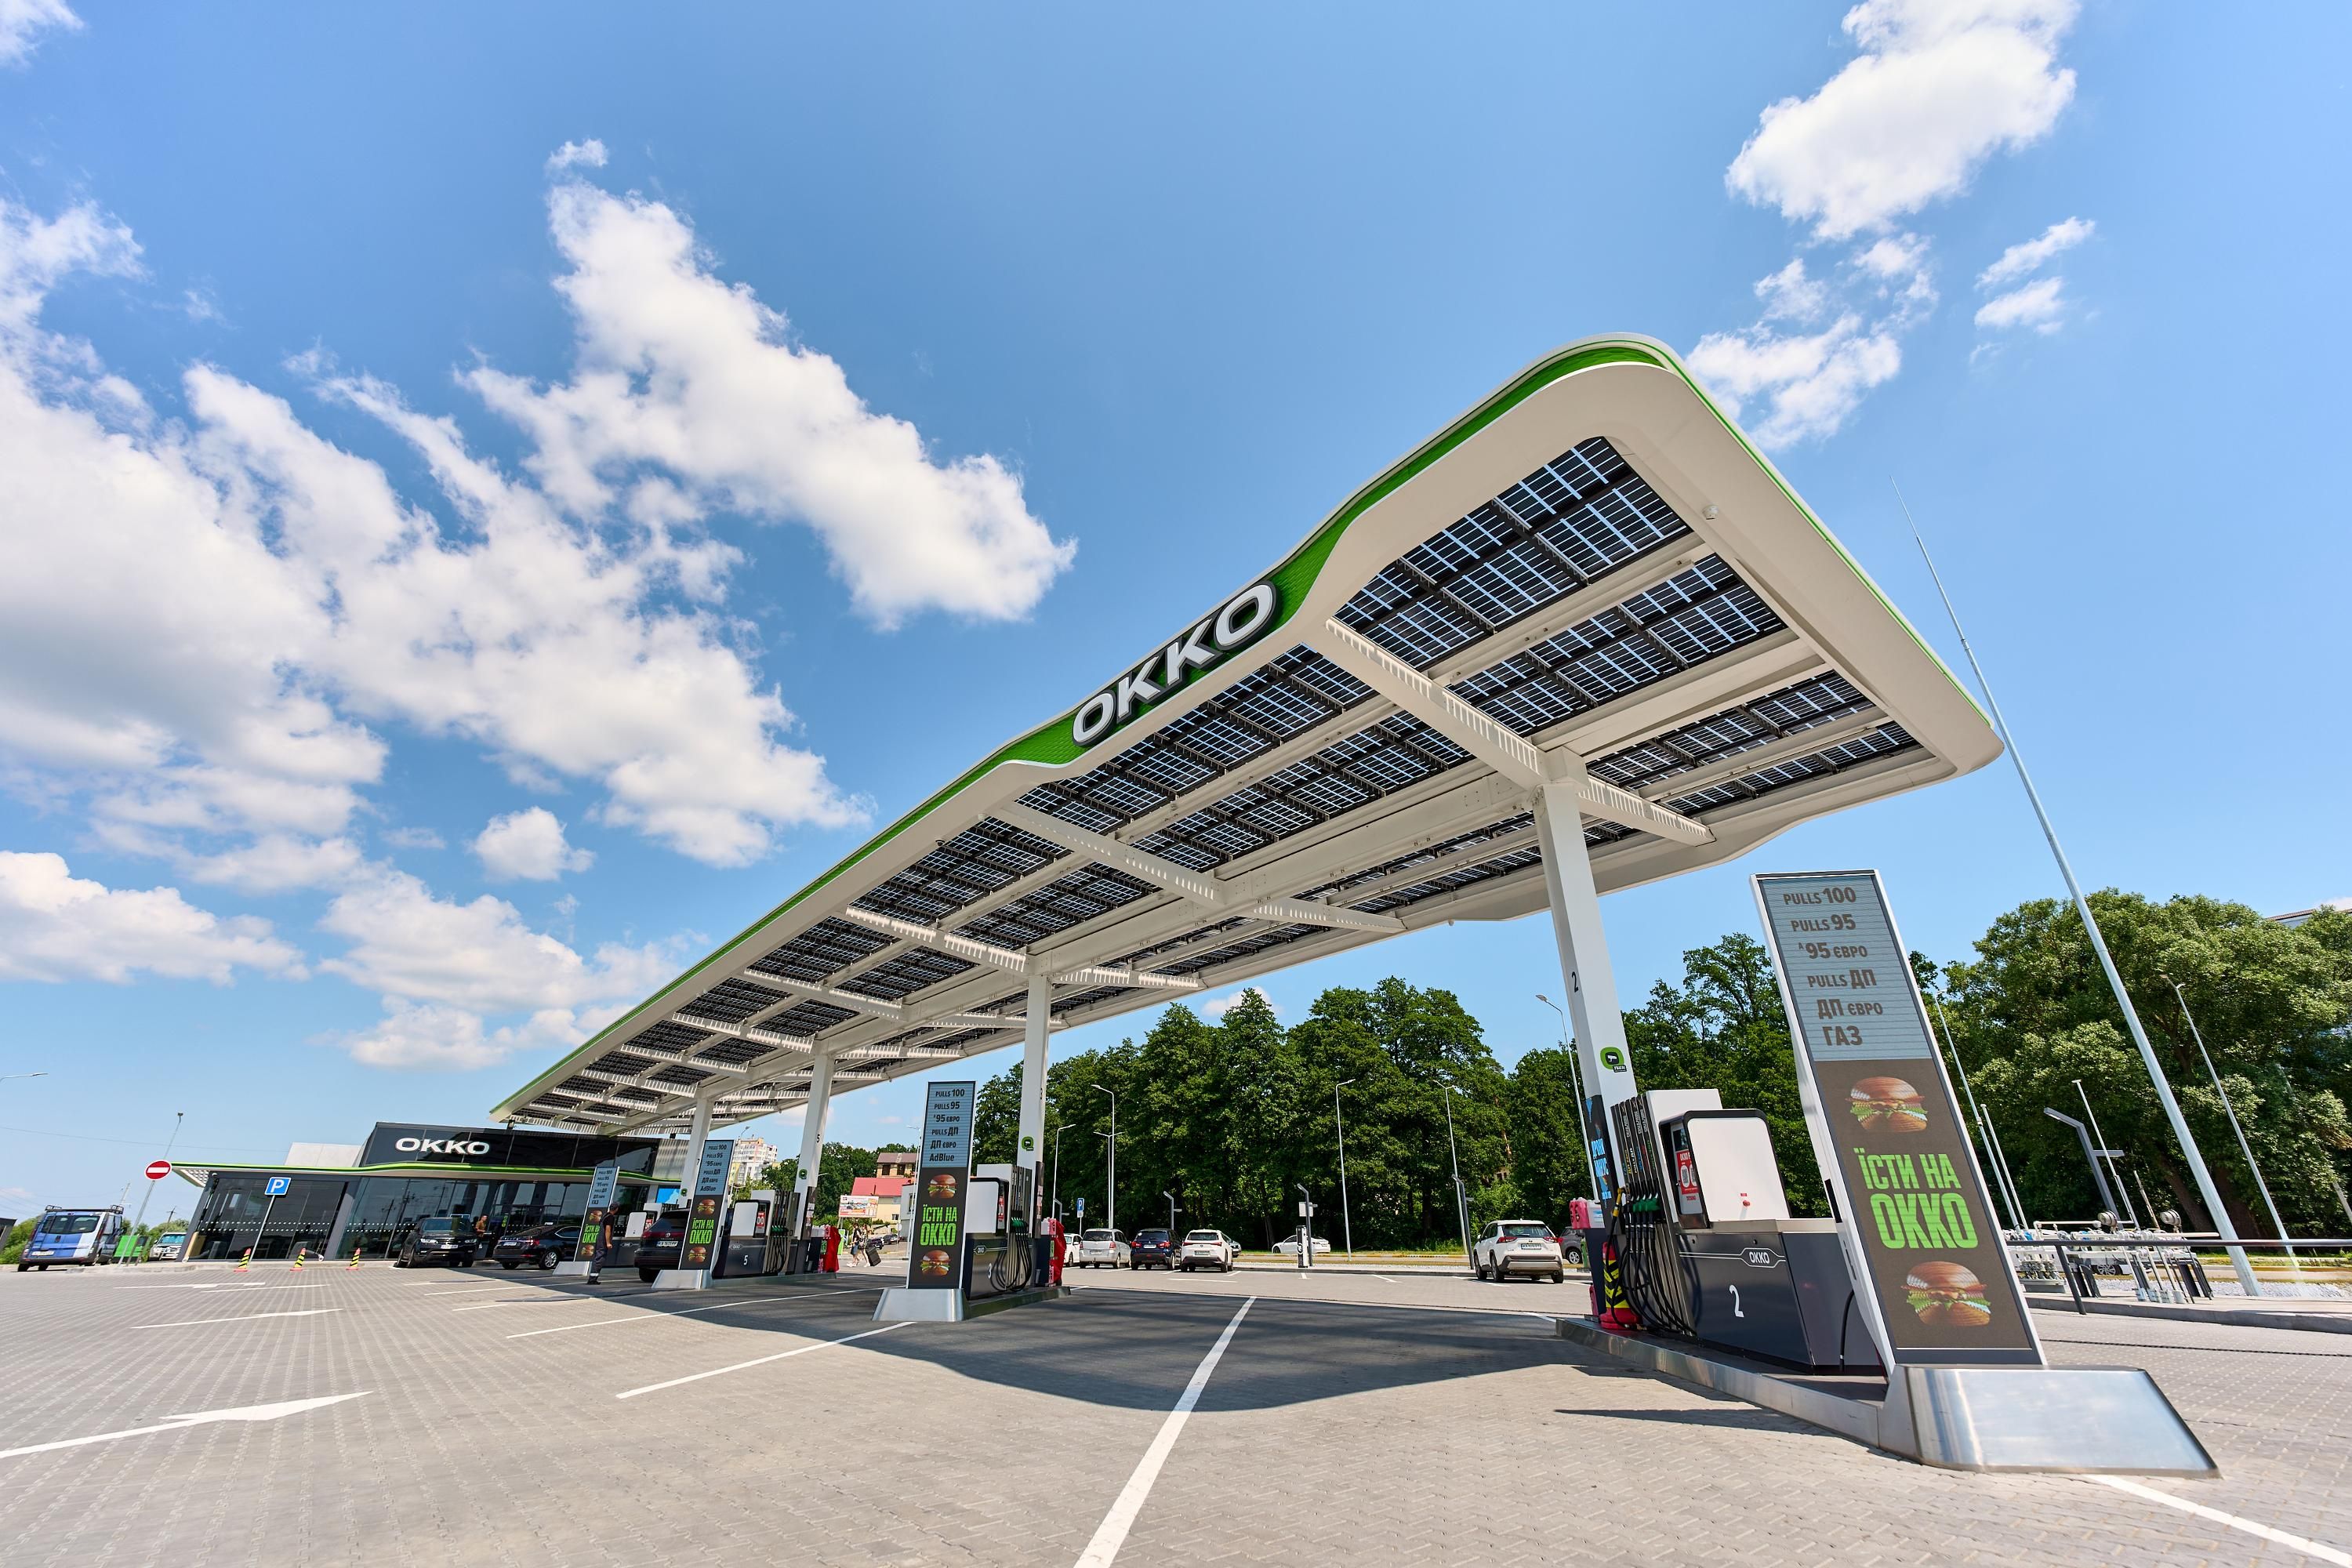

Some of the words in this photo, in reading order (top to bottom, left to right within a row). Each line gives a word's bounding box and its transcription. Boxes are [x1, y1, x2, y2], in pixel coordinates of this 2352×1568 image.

[1072, 583, 1275, 744] OKKO
[1783, 892, 1822, 906] PULLS
[1823, 887, 1857, 903] 100
[1791, 919, 1830, 932] PULLS
[1831, 913, 1857, 931] 95
[1833, 946, 1867, 958] ЄВРО
[1571, 971, 1579, 993] 2
[1807, 975, 1848, 988] PULLS
[1849, 969, 1877, 989] ДП
[1817, 999, 1844, 1019] ДП
[1848, 1002, 1883, 1015] ЄВРО
[1823, 1025, 1863, 1046] ГАЗ
[816, 1134, 820, 1143] 5
[947, 1127, 959, 1136] ДП
[395, 1138, 490, 1155] OKKO
[931, 1140, 942, 1149] ДП
[929, 1153, 955, 1162] AdBlue
[1853, 1147, 1920, 1189] ЇСТИ
[1919, 1153, 1962, 1189] НА
[270, 1178, 285, 1193] P
[922, 1203, 943, 1222] ЇСТИ
[945, 1207, 957, 1222] НА
[1078, 1200, 1083, 1210] P
[691, 1218, 706, 1229] ЇСТИ
[706, 1219, 714, 1229] НА
[1870, 1192, 1978, 1249] ОККО
[689, 1229, 713, 1244] ОККО
[920, 1222, 956, 1246] ОККО
[743, 1254, 749, 1265] 5
[1748, 1251, 1770, 1264] OKKO
[987, 1262, 993, 1279] 3
[1729, 1284, 1744, 1318] 2
